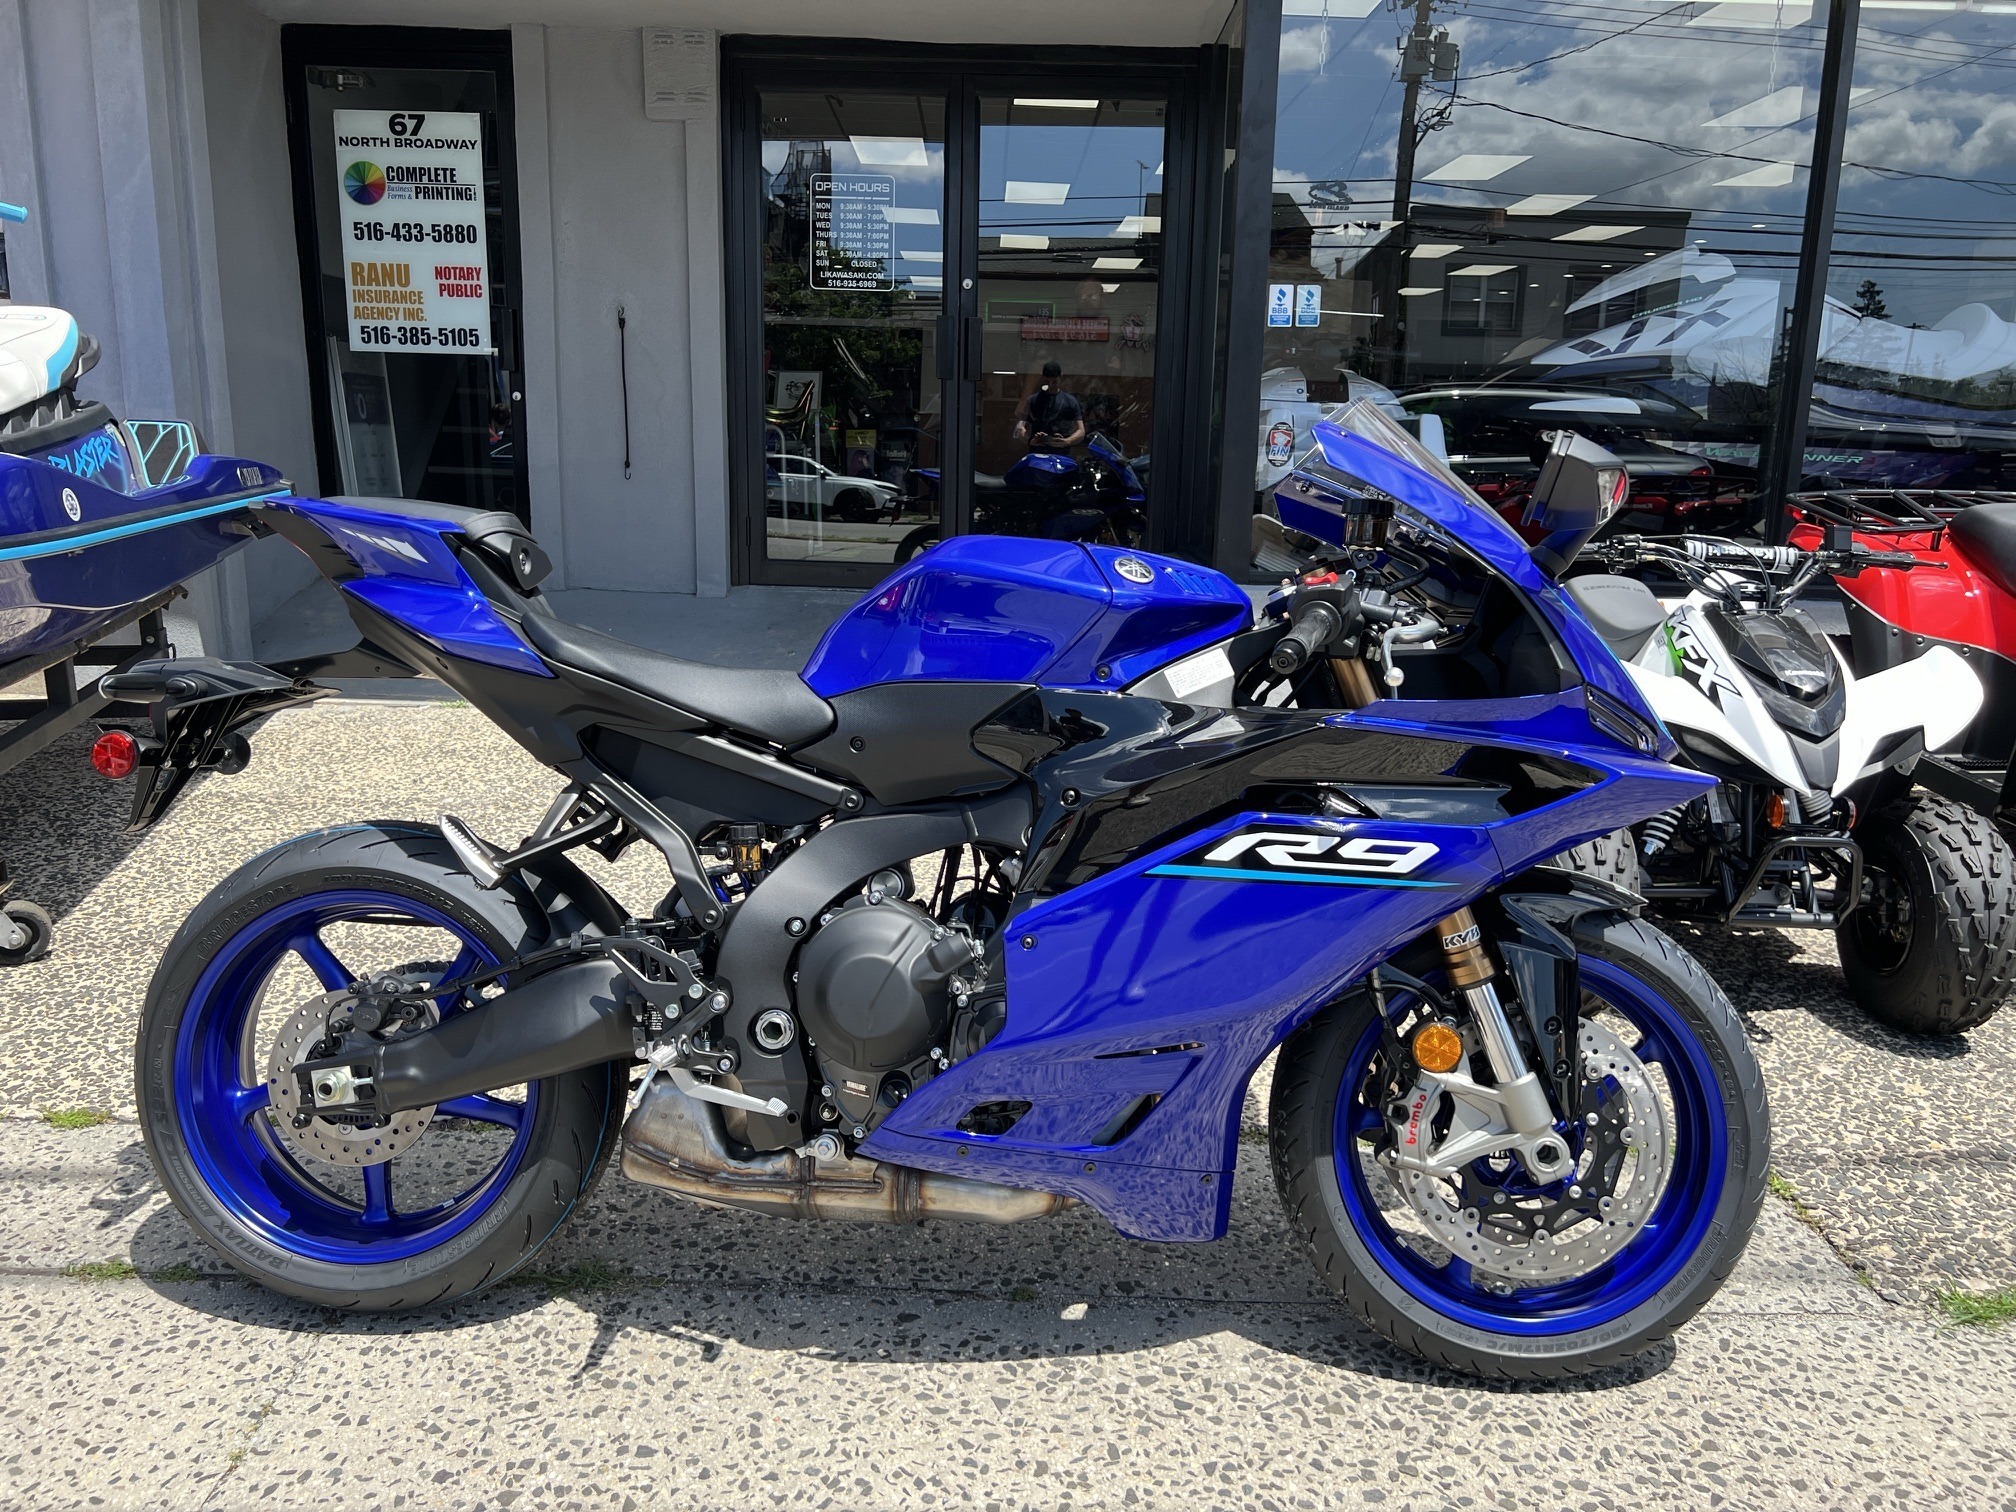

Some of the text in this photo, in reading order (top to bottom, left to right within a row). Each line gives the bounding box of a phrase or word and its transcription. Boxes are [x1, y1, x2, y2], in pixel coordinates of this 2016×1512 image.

[388, 113, 426, 137] 67
[338, 136, 478, 150] NORTH BROADWAY
[385, 165, 457, 183] COMPLETE
[386, 185, 413, 193] Business
[414, 186, 472, 201] PRINTING
[815, 182, 890, 192] OPEN HOURS
[353, 221, 478, 244] 516-433-5880
[351, 262, 411, 287] RANU
[434, 266, 482, 281] NOTARY
[352, 290, 424, 305] INSURANCE
[438, 283, 483, 298] PUBLIC
[353, 306, 427, 322] AGENCY INC.
[360, 325, 480, 347] 516-385-5105
[1708, 544, 1774, 560] Kawasaki
[1667, 606, 1743, 699] KFX
[1204, 832, 1440, 874] R9
[200, 882, 296, 952] BRIDGESTONE
[1443, 925, 1480, 949] KYB
[1405, 1094, 1427, 1145] brembo
[409, 1202, 507, 1276] BRIDGESTONE
[1664, 1226, 1723, 1303] BRIDGESTONE
